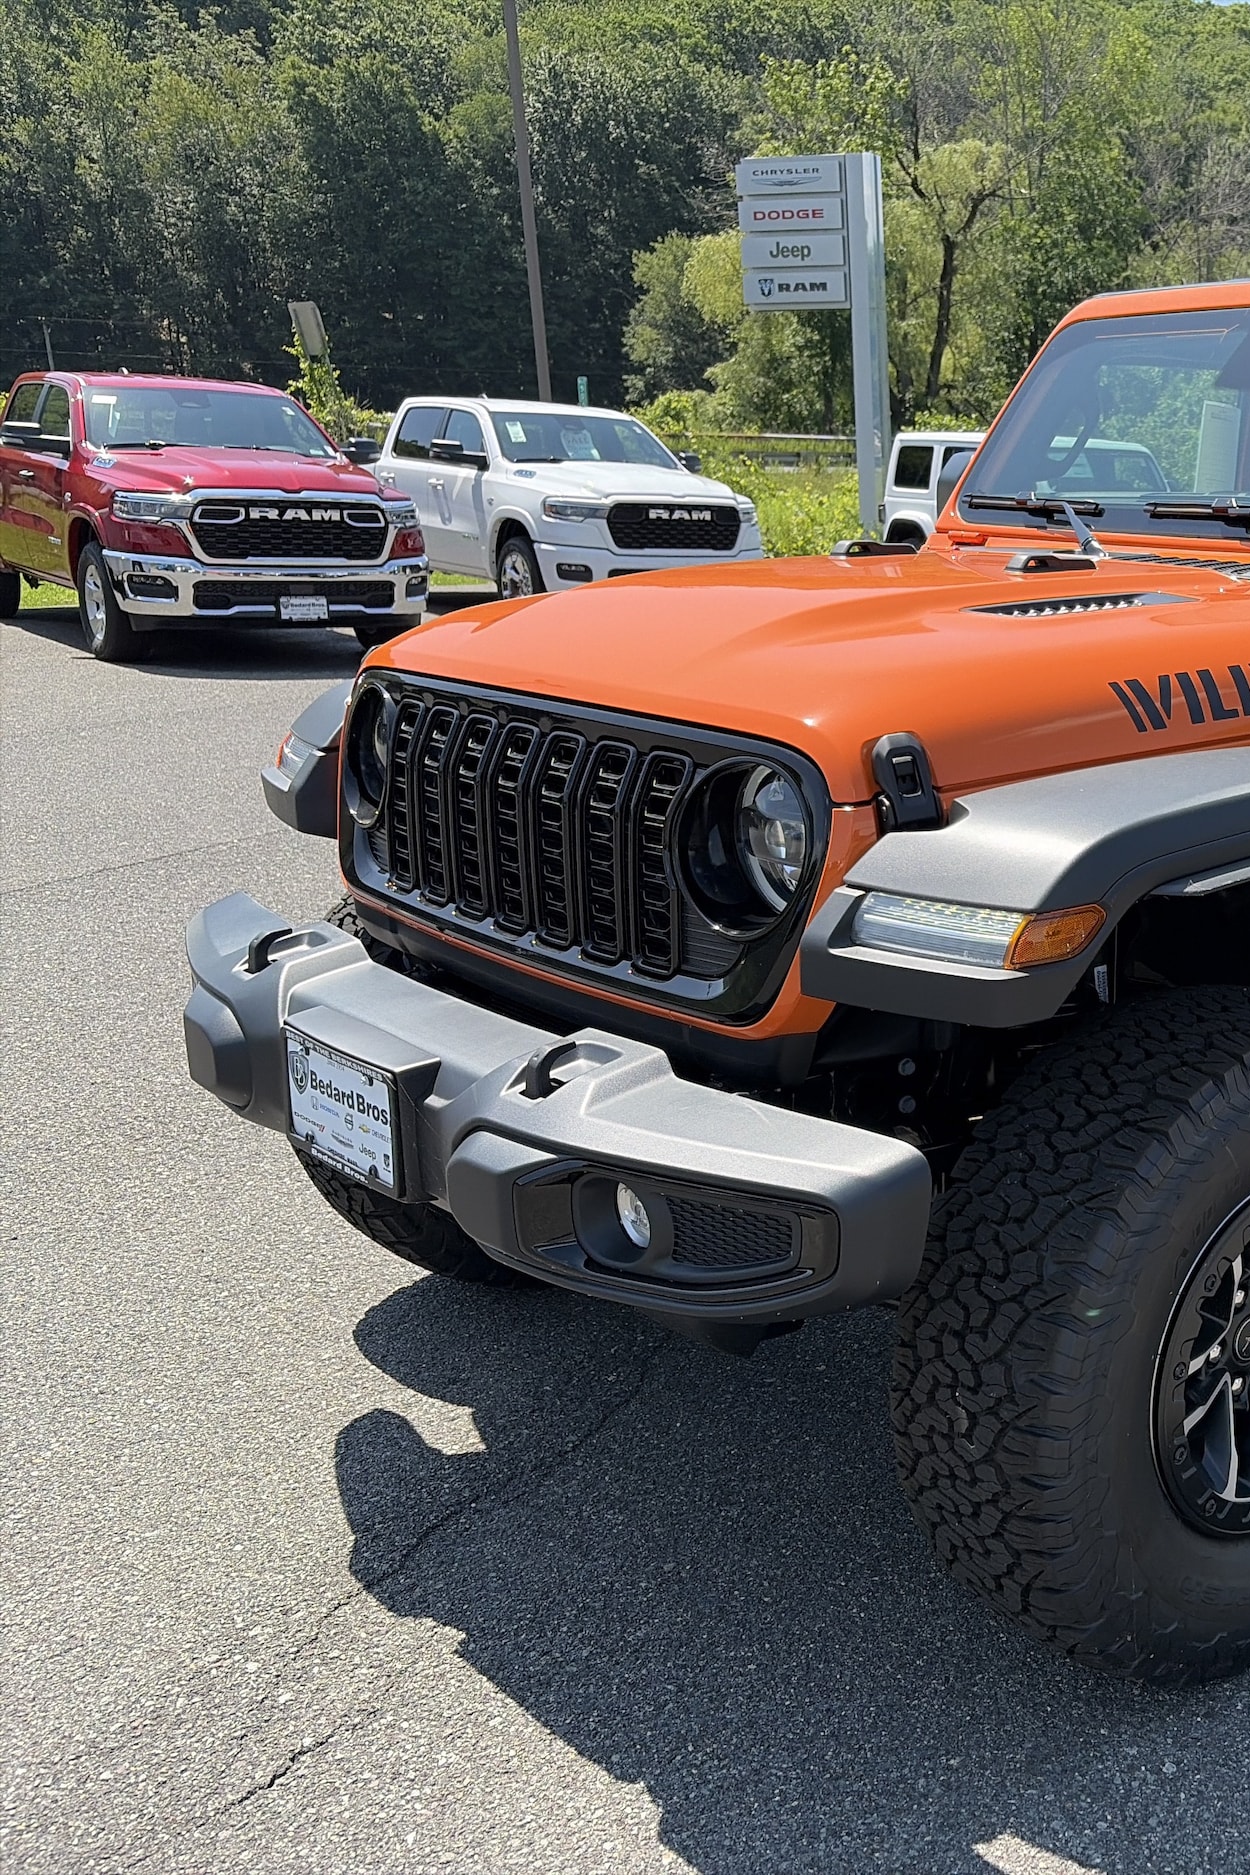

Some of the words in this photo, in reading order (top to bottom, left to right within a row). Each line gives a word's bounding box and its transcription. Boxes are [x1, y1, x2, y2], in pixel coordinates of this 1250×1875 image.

[752, 167, 820, 176] CHRYSLER
[753, 208, 824, 221] DODGE
[769, 241, 811, 261] Jeep
[777, 282, 828, 293] RAM
[249, 507, 341, 521] RAM
[648, 509, 712, 521] RAM
[310, 1069, 354, 1111] Bedard
[359, 1143, 377, 1160] Jeep
[311, 1148, 342, 1169] Bedard
[343, 1165, 369, 1184] Bros.
